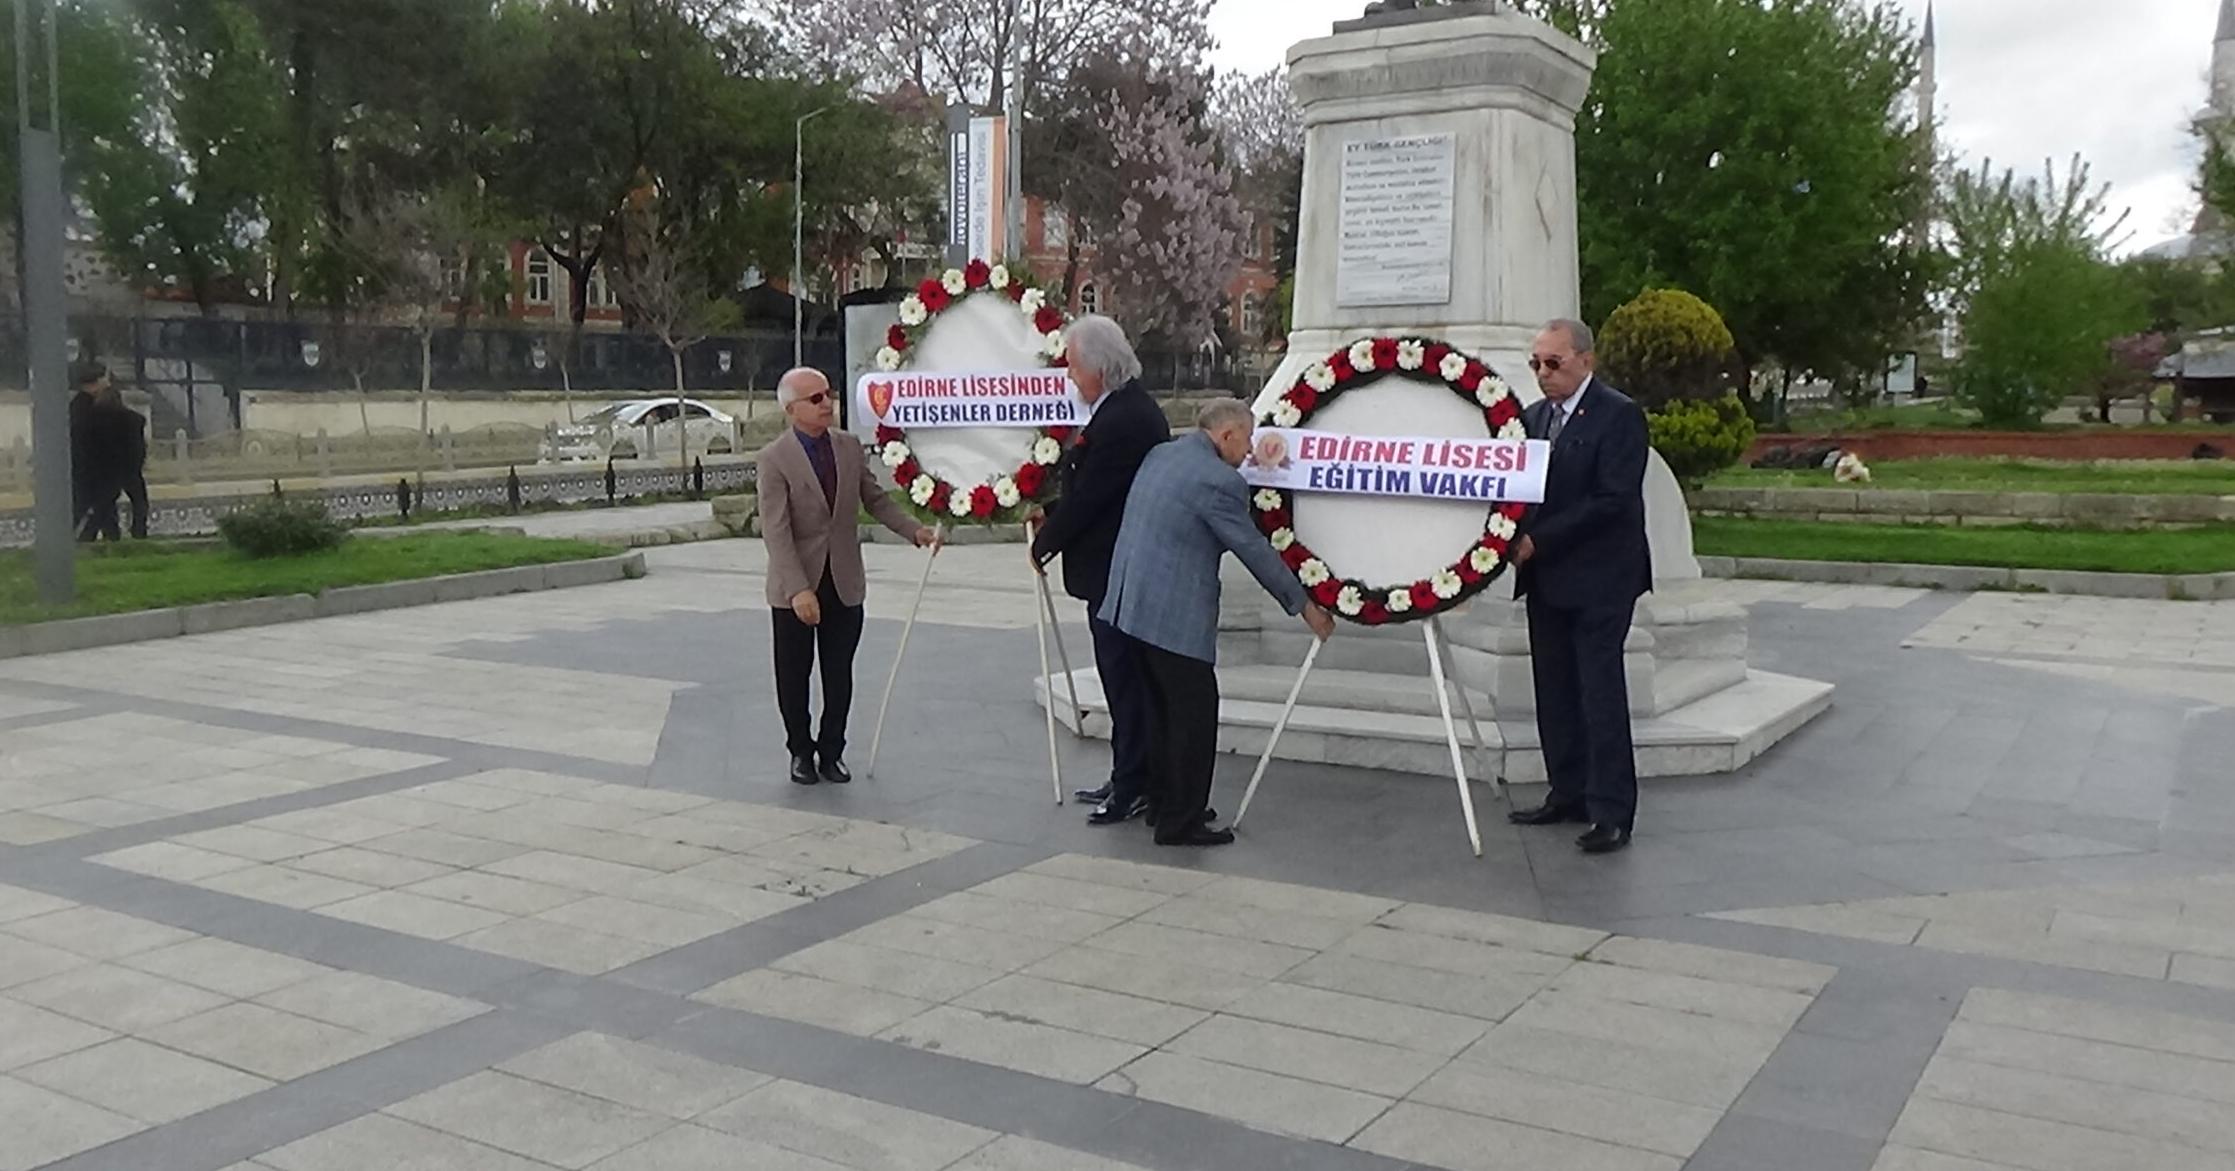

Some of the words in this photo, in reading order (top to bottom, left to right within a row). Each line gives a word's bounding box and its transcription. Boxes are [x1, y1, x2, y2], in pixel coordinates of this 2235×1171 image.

[898, 376, 957, 398] EDİRNE
[962, 373, 1065, 397] LİSESİNDEN
[892, 401, 991, 424] YETİŞENLER
[997, 400, 1075, 422] DERNEĞİ
[1300, 436, 1416, 464] EDİRNE
[1422, 440, 1527, 472] LİSESİ
[1309, 462, 1410, 493] EĞİTİM
[1419, 471, 1507, 498] VAKFI
